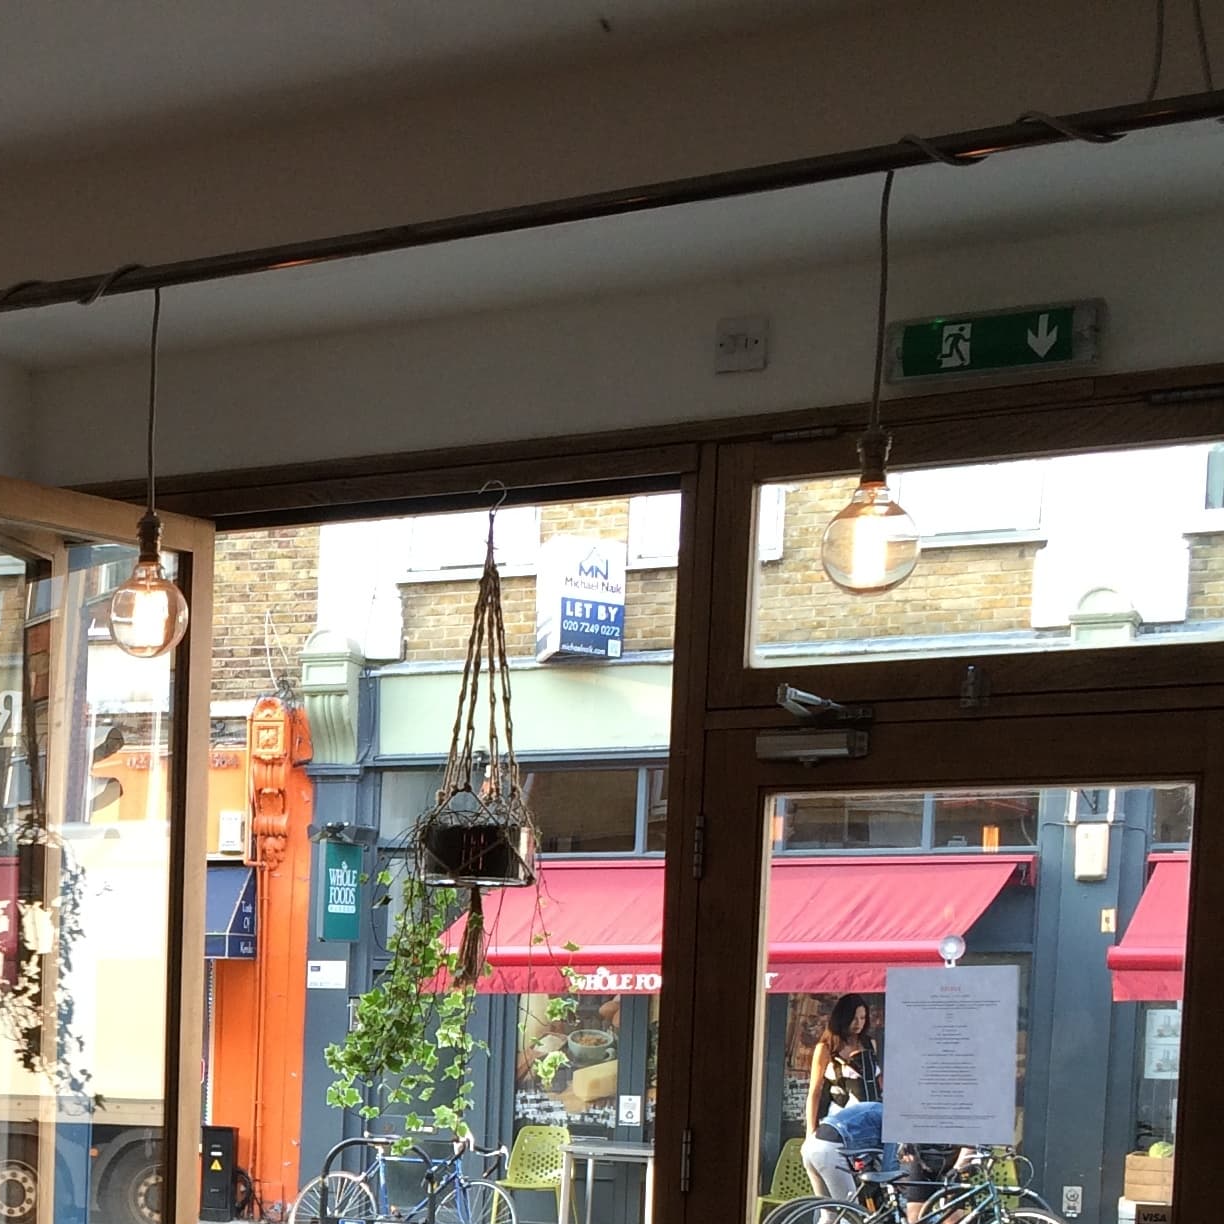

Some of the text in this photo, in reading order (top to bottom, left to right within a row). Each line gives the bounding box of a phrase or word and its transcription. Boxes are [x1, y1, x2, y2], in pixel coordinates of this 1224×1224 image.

[564, 576, 599, 590] Michael
[566, 601, 618, 622] LET BY
[563, 619, 620, 636] 020 7249 0272
[329, 868, 358, 887] WHOLE
[329, 887, 356, 904] FOODS
[570, 970, 632, 990] WHOLE
[1142, 1213, 1167, 1222] VISA
